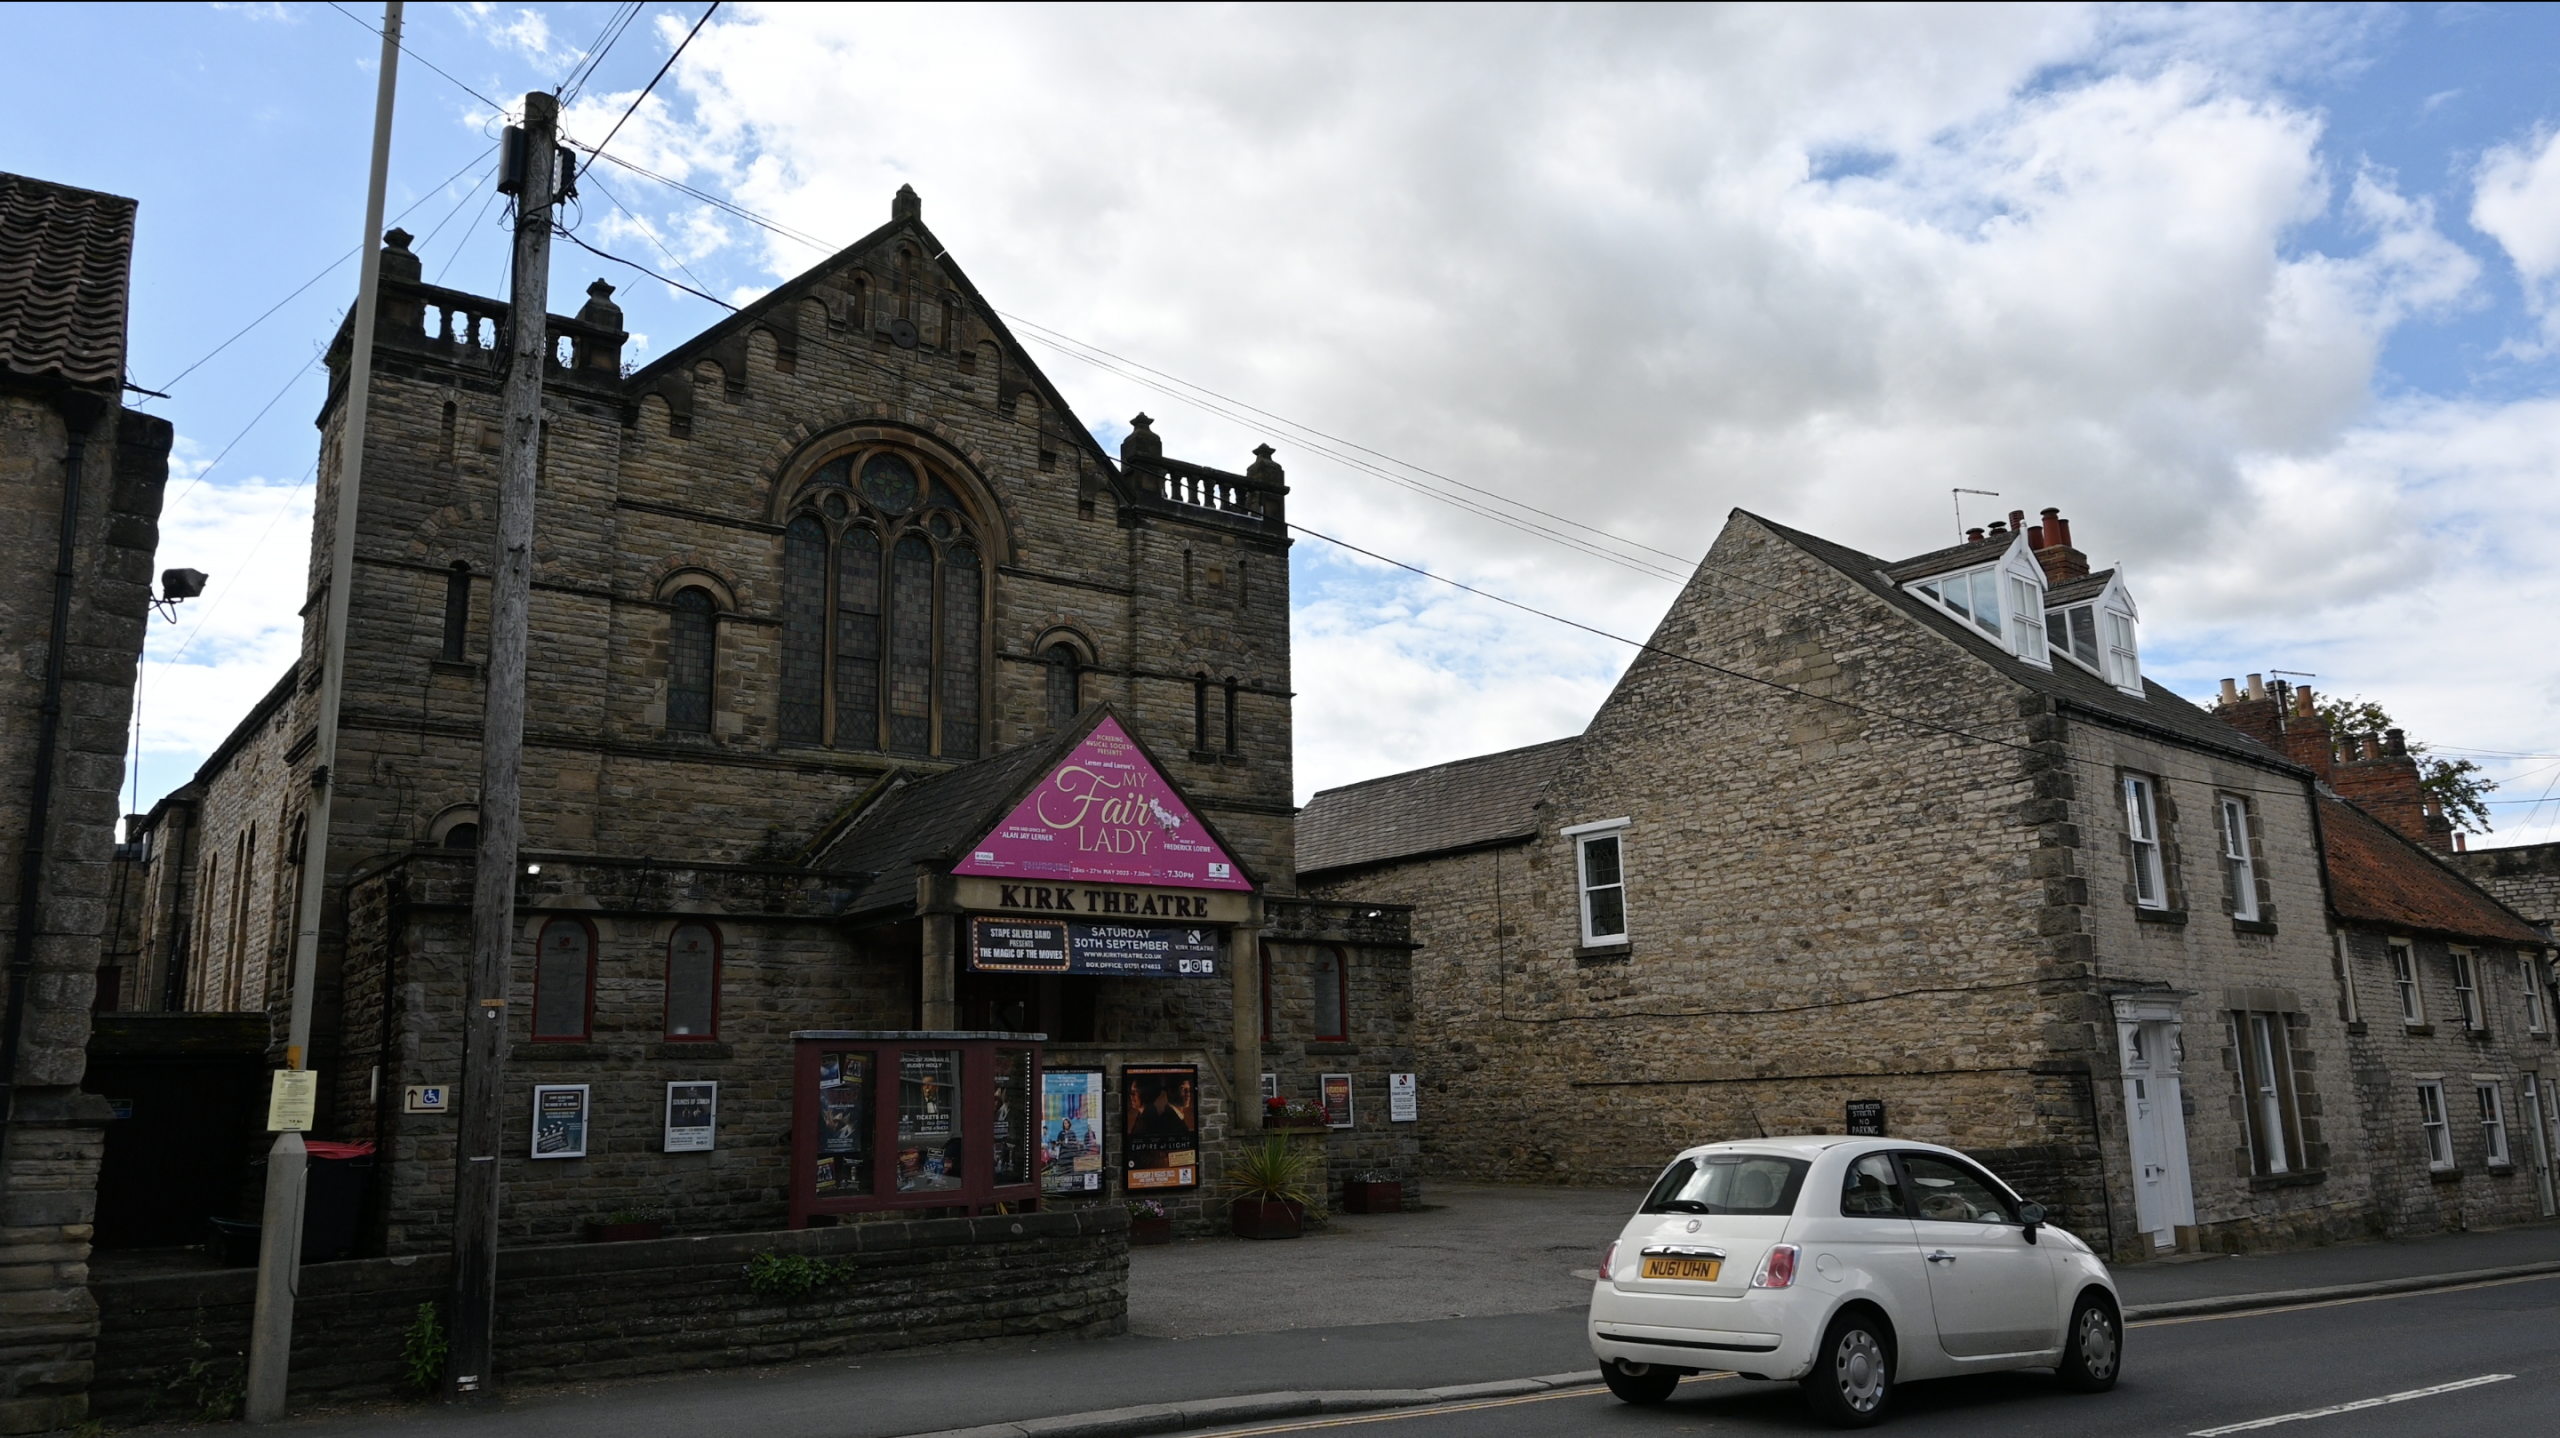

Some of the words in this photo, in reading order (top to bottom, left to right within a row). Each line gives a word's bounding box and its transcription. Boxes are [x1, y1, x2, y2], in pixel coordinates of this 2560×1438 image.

[1096, 734, 1123, 742] PICKERING
[1098, 748, 1122, 756] PRESENTS
[1123, 772, 1148, 788] MY
[1038, 766, 1152, 829] Fair
[1078, 826, 1153, 855] LADY
[1164, 843, 1192, 851] FREDERICK
[1167, 870, 1194, 879] 7.30PM
[1000, 884, 1076, 911] KIRK
[1084, 890, 1209, 918] THEATRE
[990, 928, 1010, 938] STAPE
[1012, 929, 1033, 939] SILVER
[1034, 930, 1051, 939] BAND
[1092, 927, 1150, 938] SATURDAY
[1074, 938, 1102, 948] 30TH
[1106, 940, 1169, 950] SEPTEMBER
[980, 948, 992, 957] THE
[993, 948, 1015, 958] MAGIC
[1017, 949, 1024, 958] OF
[1026, 949, 1038, 958] THE
[1039, 950, 1063, 959] MOVIES
[1852, 1126, 1879, 1135] PARKING
[1650, 1261, 1681, 1276] NU61
[1683, 1262, 1711, 1277] UHN
